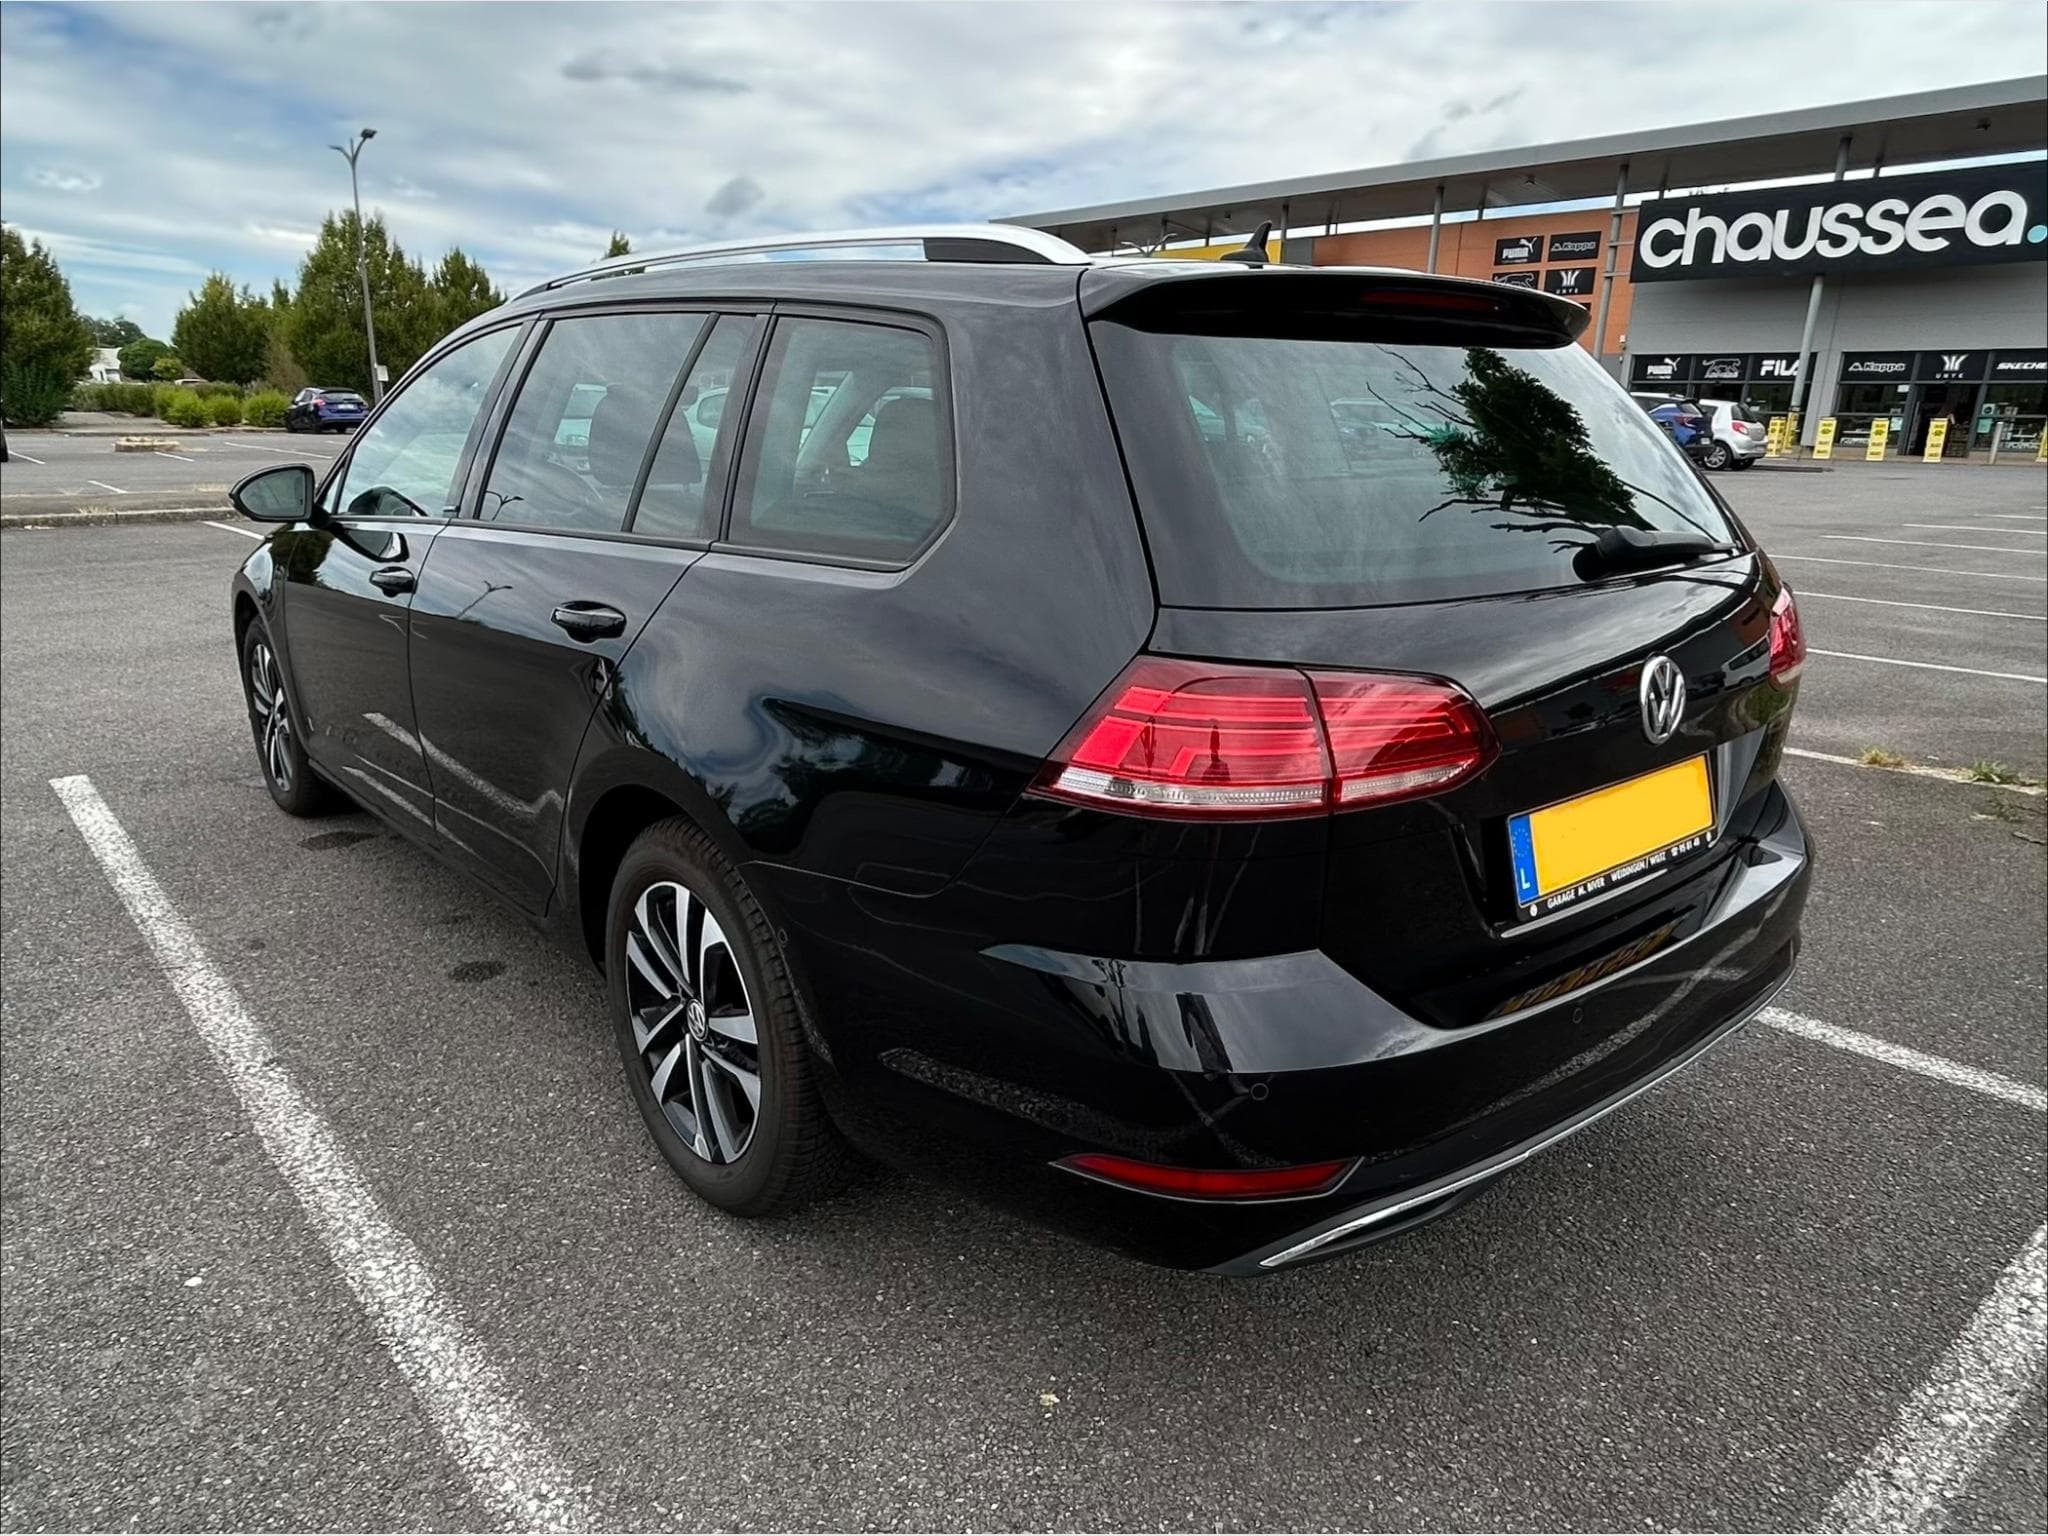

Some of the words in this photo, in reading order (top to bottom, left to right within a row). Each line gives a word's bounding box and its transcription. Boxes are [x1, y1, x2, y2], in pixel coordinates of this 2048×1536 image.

[1562, 241, 1597, 252] Kappa
[1863, 362, 1906, 372] Kappa
[1520, 868, 1530, 889] L
[1547, 889, 1575, 909] GARAGE
